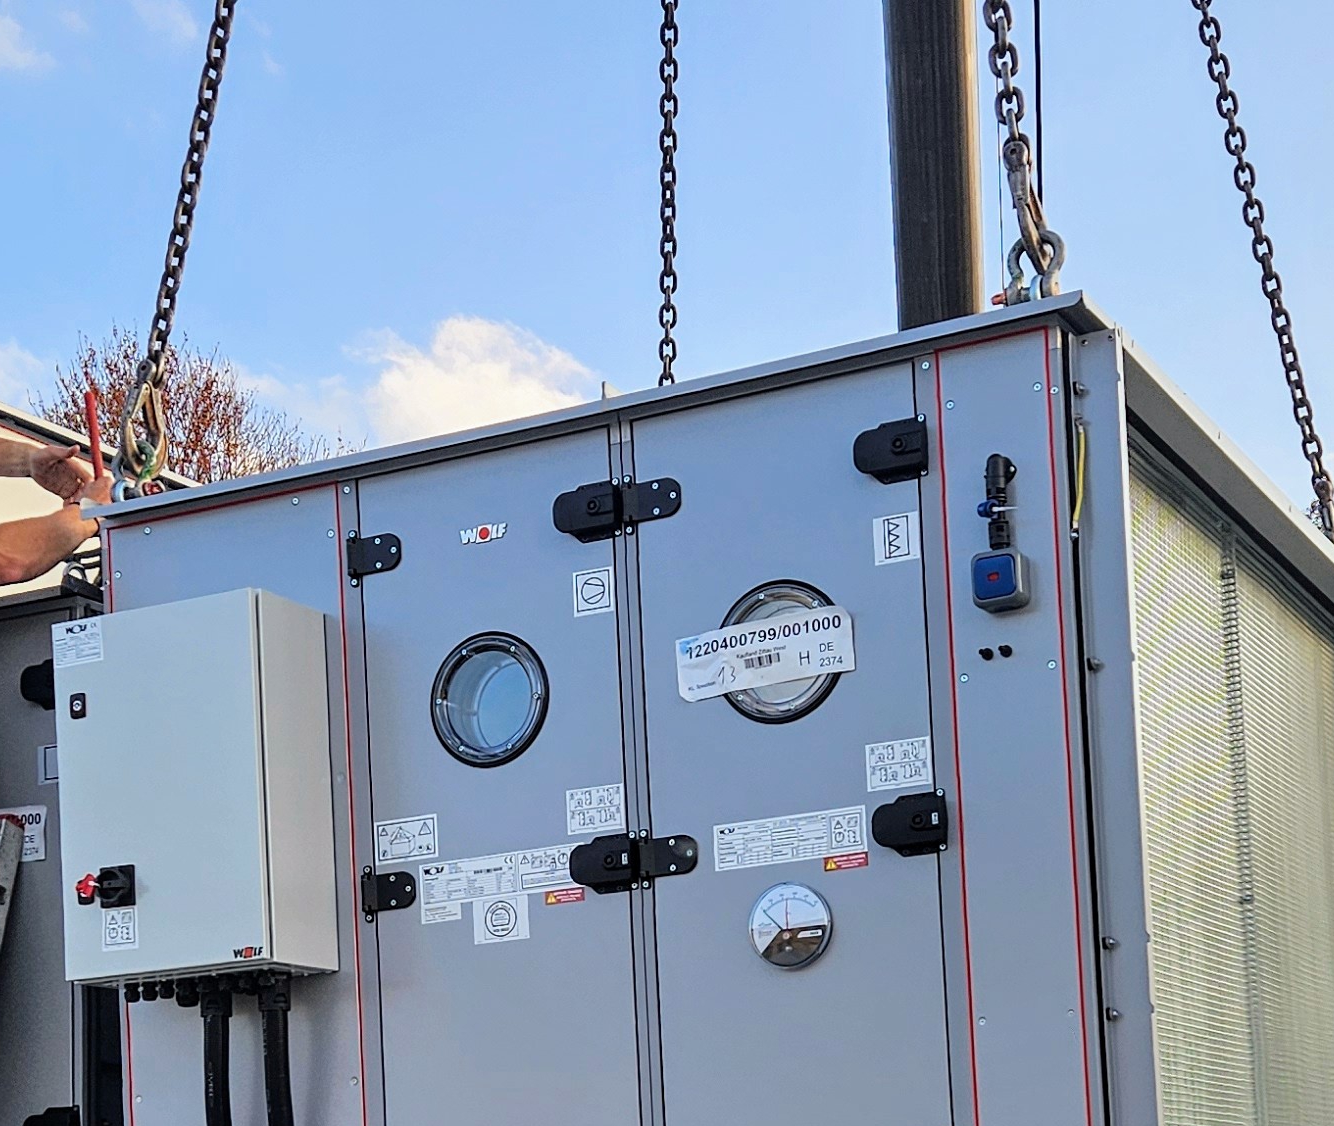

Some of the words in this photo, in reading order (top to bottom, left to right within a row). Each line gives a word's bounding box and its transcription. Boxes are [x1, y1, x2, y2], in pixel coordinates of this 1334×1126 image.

[459, 522, 508, 545] WOLF
[686, 615, 842, 659] 1220400799/001000
[819, 641, 835, 653] DE
[798, 650, 811, 666] H
[819, 656, 844, 667] 2374
[233, 946, 263, 959] WOLF
